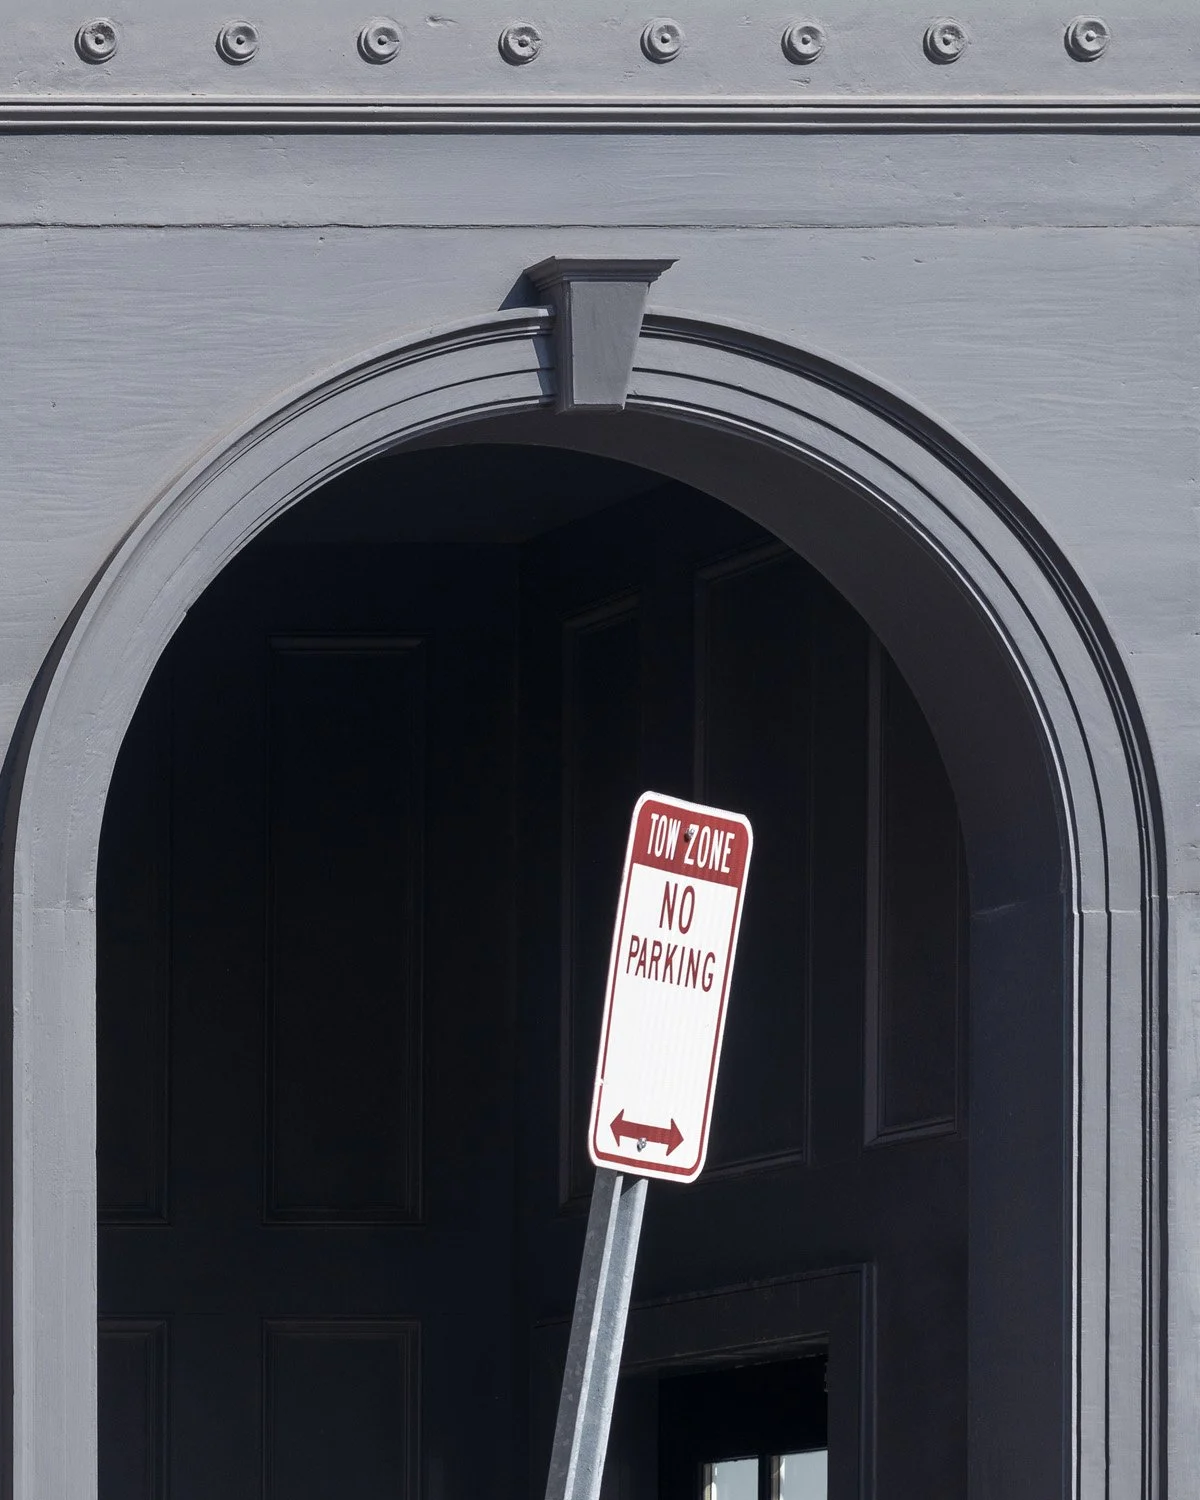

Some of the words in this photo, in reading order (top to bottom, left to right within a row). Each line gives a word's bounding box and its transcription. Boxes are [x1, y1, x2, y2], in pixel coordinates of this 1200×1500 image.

[647, 813, 681, 860] TOW
[684, 824, 735, 874] ZONE
[659, 881, 696, 934] NO
[626, 934, 716, 992] PARKING
